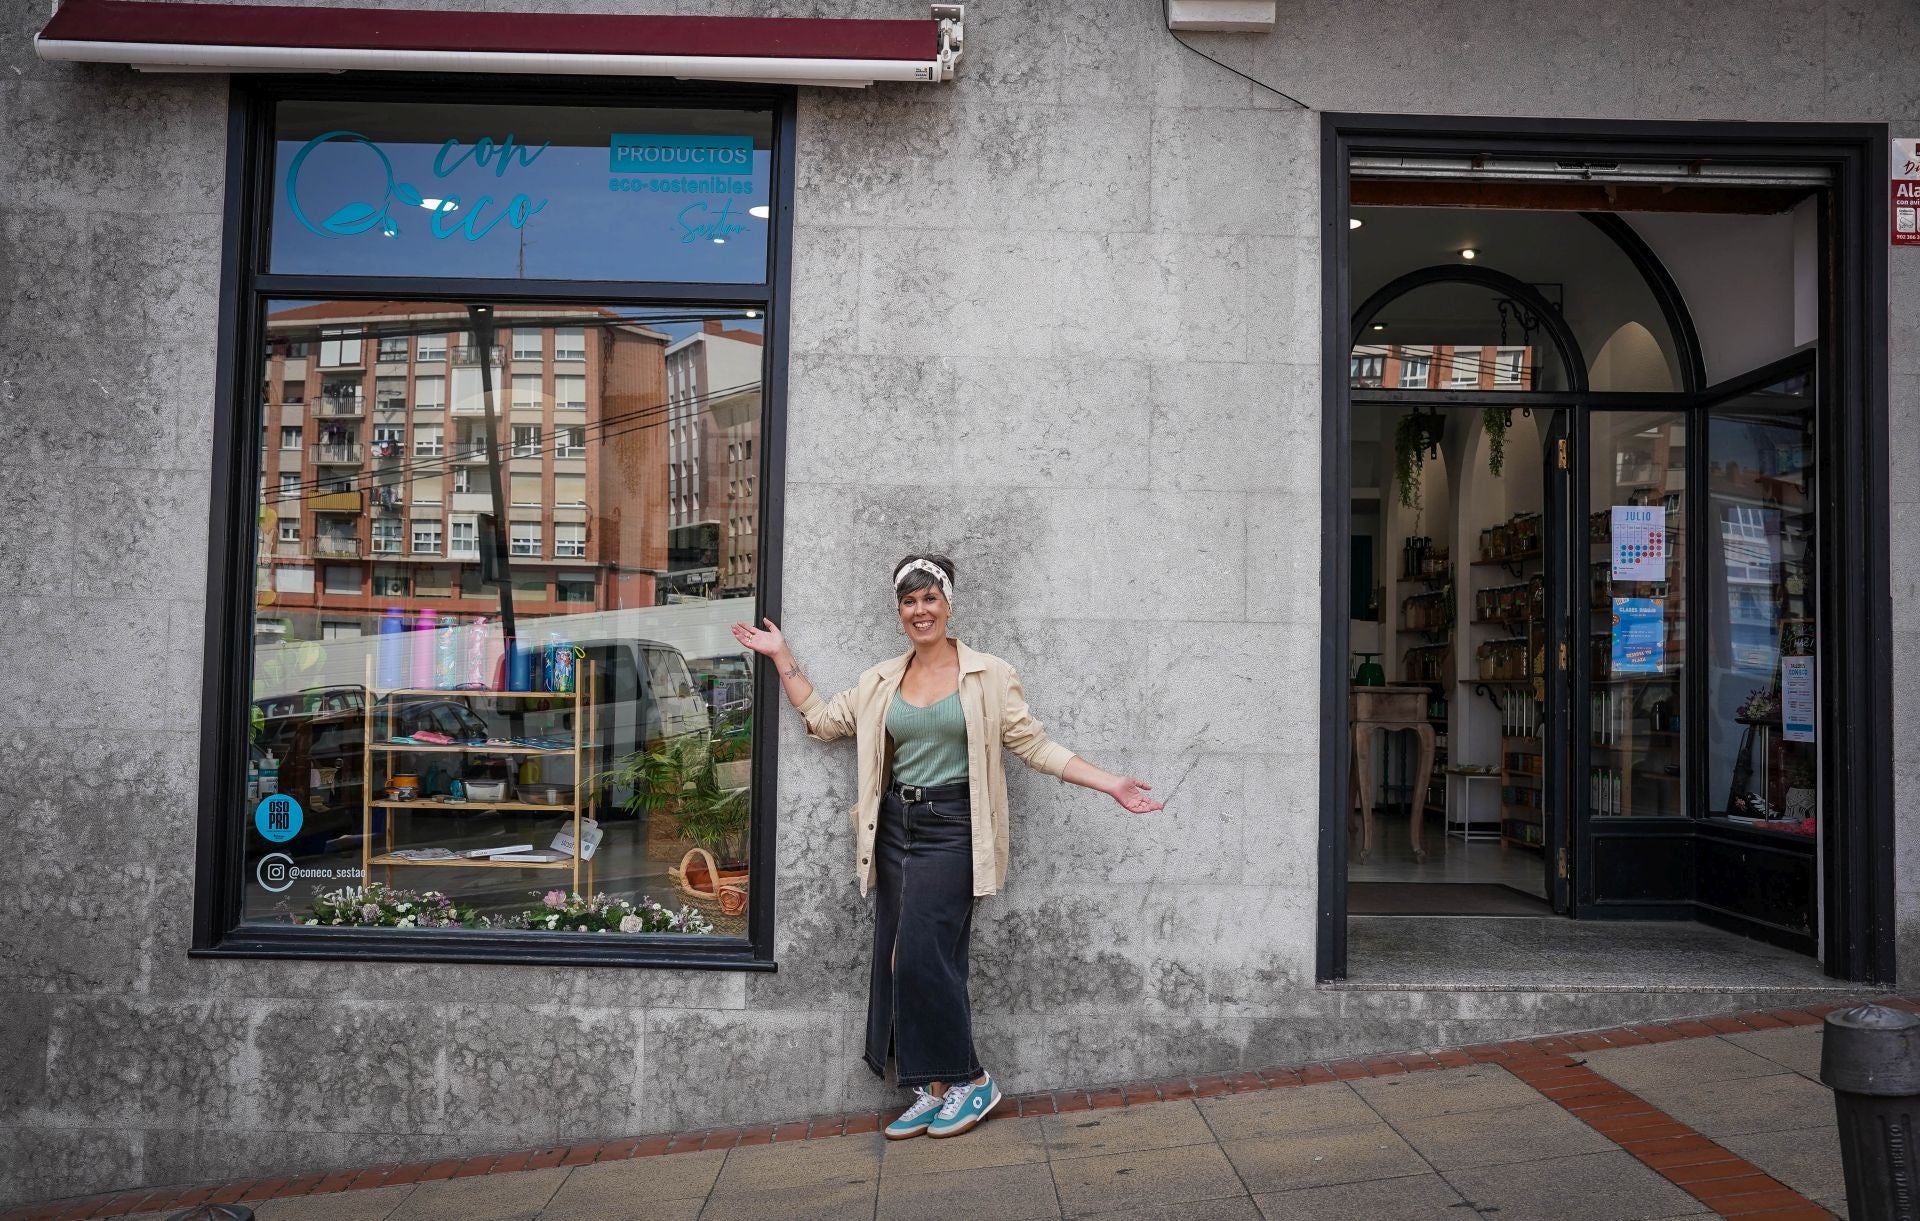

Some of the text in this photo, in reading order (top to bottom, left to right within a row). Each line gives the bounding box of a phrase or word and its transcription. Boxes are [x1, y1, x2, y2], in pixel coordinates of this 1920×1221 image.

[433, 131, 551, 178] con
[617, 145, 747, 164] PRODUCTOS
[608, 176, 753, 194] eco-sostenibles
[431, 193, 549, 242] eco
[1625, 511, 1651, 521] JULIO
[268, 812, 290, 830] PRO
[288, 866, 366, 880] @coneco_sestao
